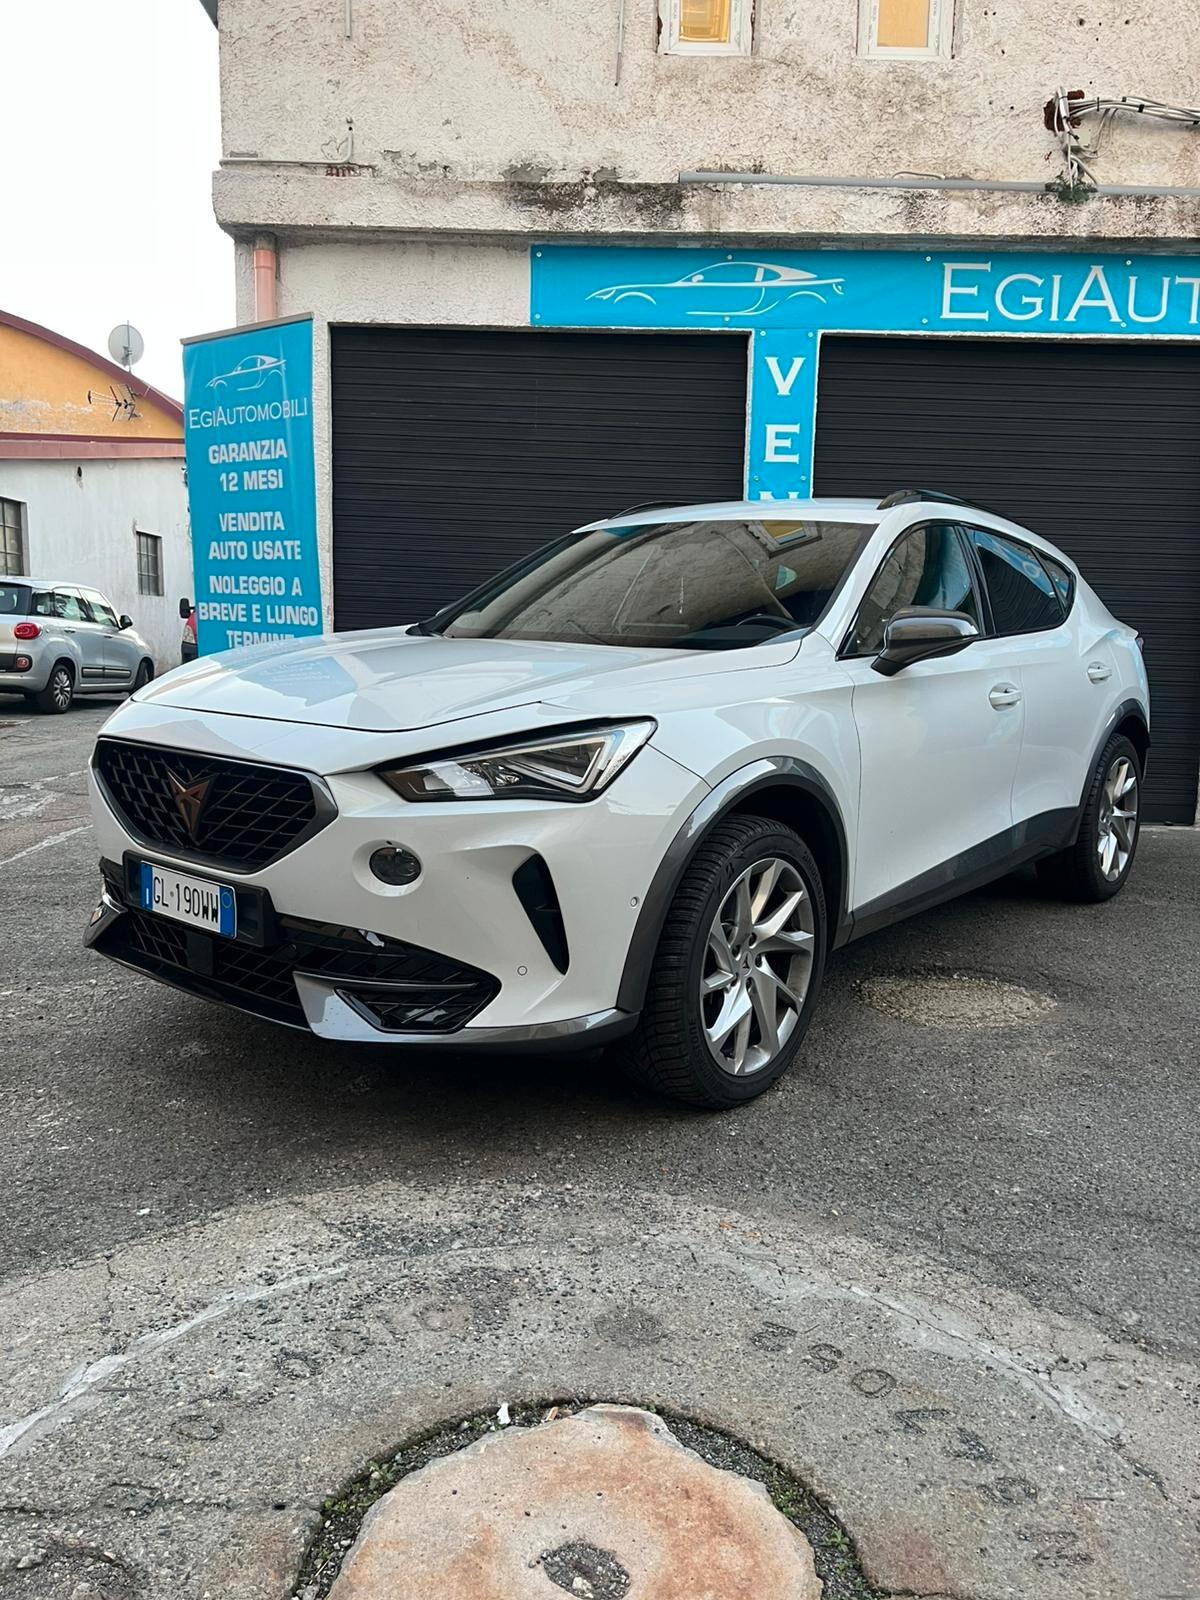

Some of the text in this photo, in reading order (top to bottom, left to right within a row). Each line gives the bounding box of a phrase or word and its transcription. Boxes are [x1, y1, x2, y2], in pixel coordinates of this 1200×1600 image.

[759, 356, 807, 500] VE
[208, 438, 288, 465] GARANZIA
[219, 468, 284, 492] 12 MESI
[219, 511, 285, 532] VENDITA
[208, 540, 302, 560] AUTO USATE
[209, 575, 302, 596] NOLEGGIO A
[198, 602, 318, 627] BREVE E LUNGO
